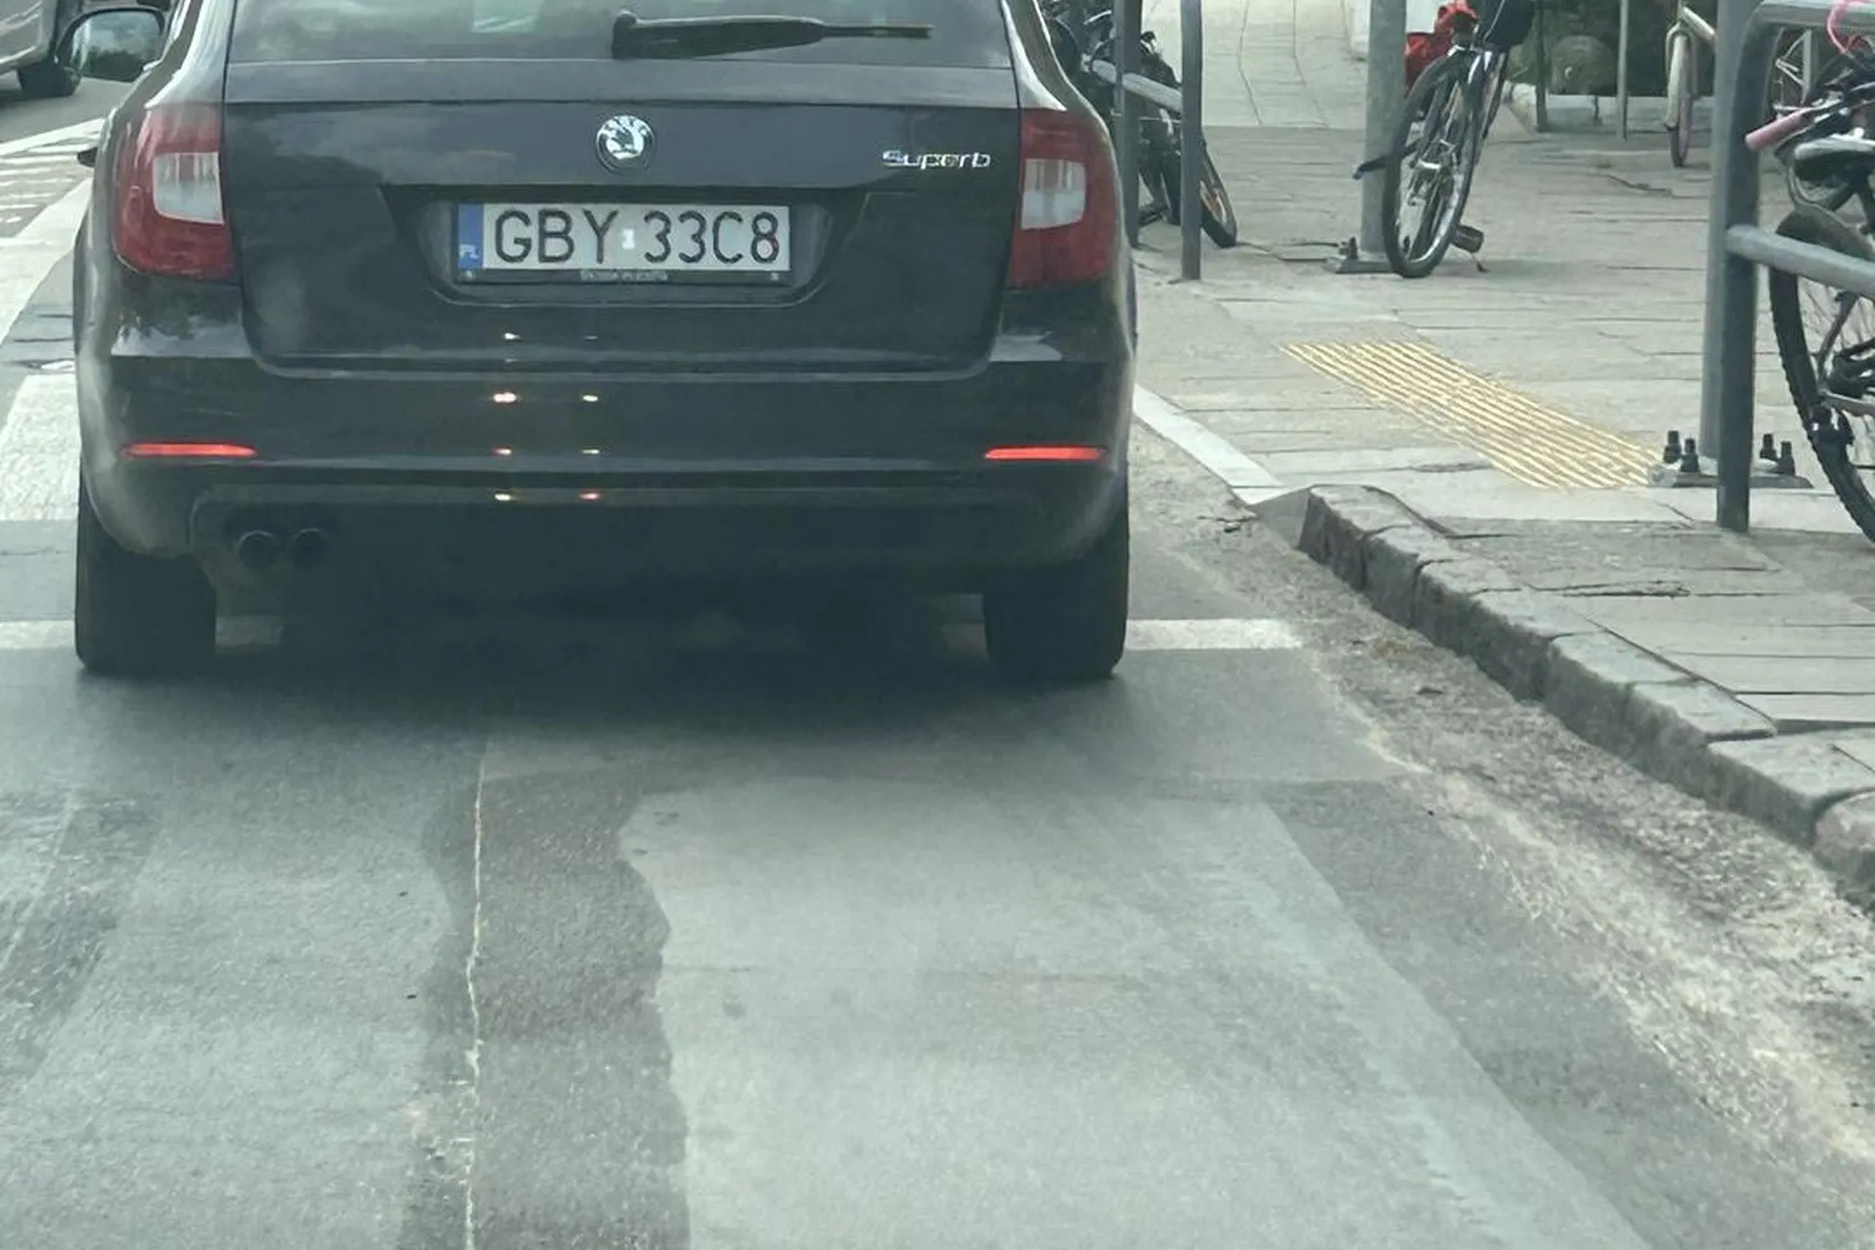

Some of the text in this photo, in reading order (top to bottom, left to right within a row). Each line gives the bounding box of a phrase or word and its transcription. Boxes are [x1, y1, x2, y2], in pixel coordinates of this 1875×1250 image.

[882, 150, 991, 170] Superb
[495, 208, 781, 265] GBY 33C8
